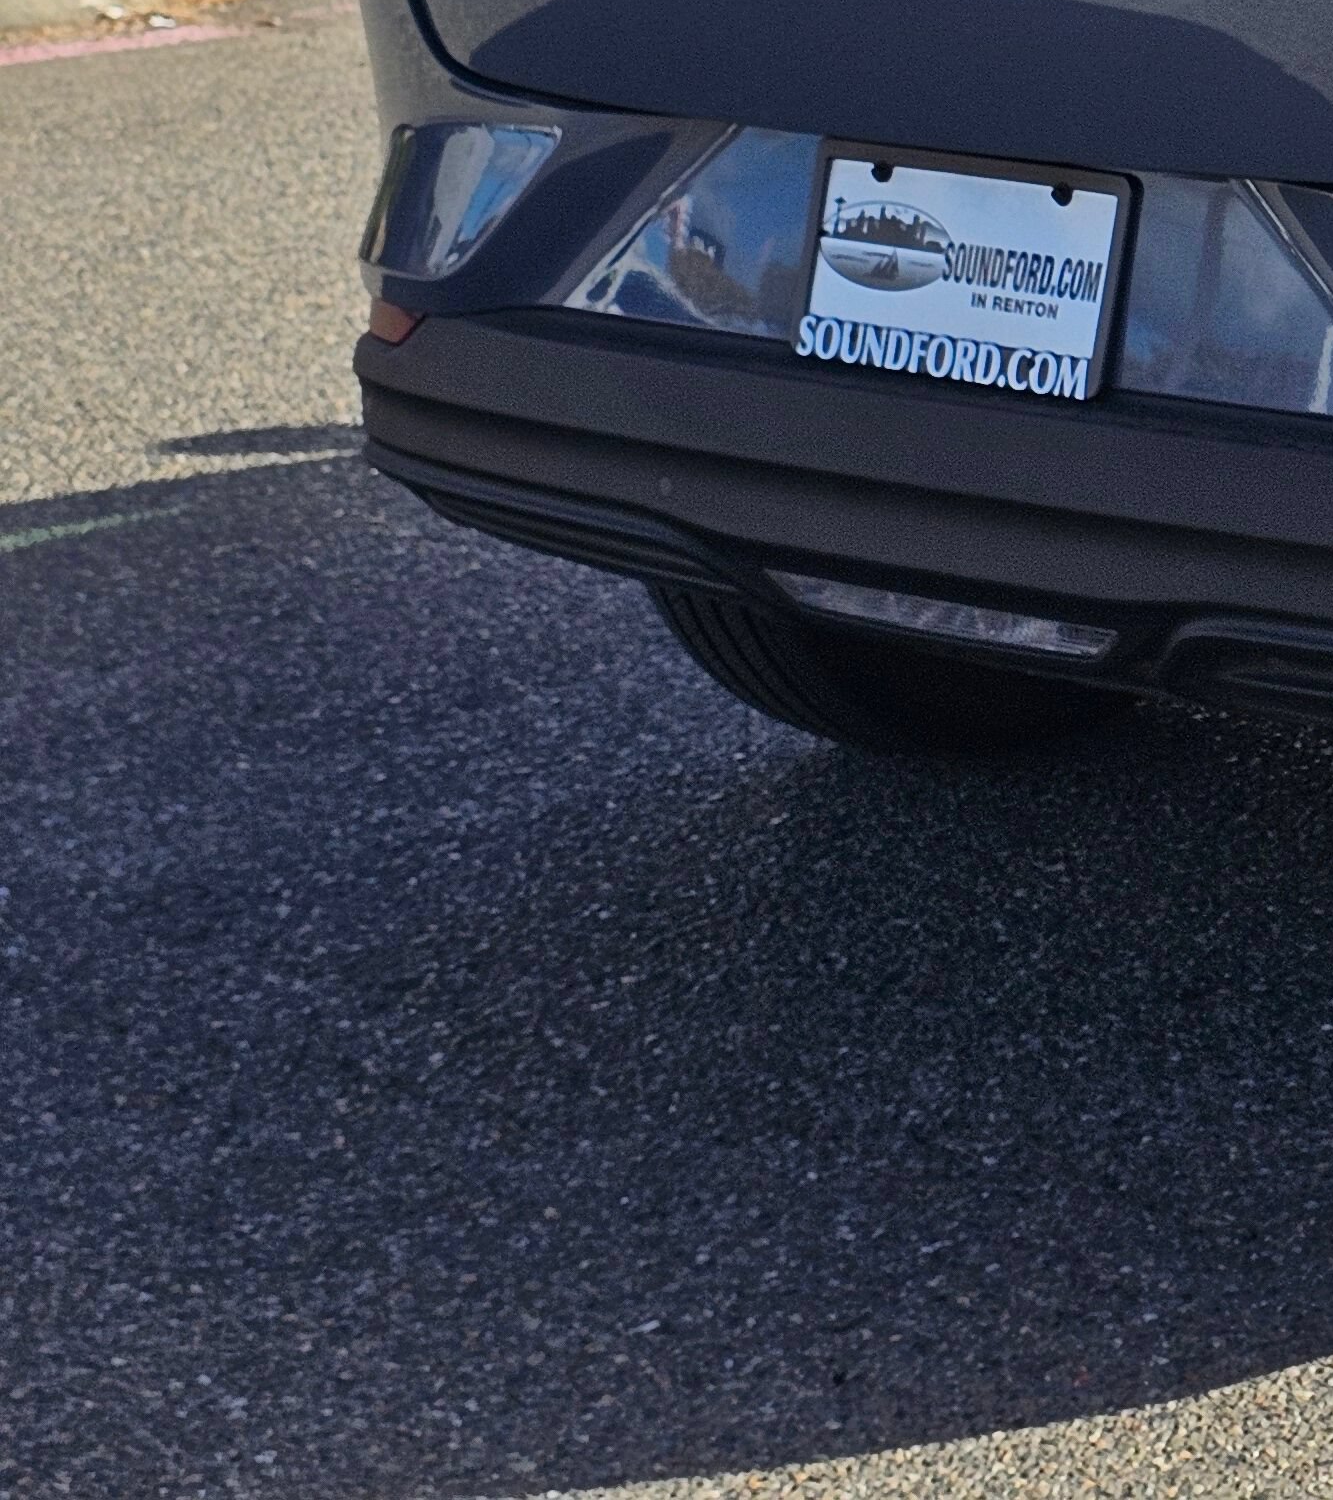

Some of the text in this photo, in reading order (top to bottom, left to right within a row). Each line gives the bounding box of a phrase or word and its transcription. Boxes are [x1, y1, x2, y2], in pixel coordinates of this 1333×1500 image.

[942, 241, 1103, 303] SOUNDFORD.COM
[970, 292, 1059, 320] IN RENTON
[796, 315, 1088, 400] SOUNDFORD.COM
